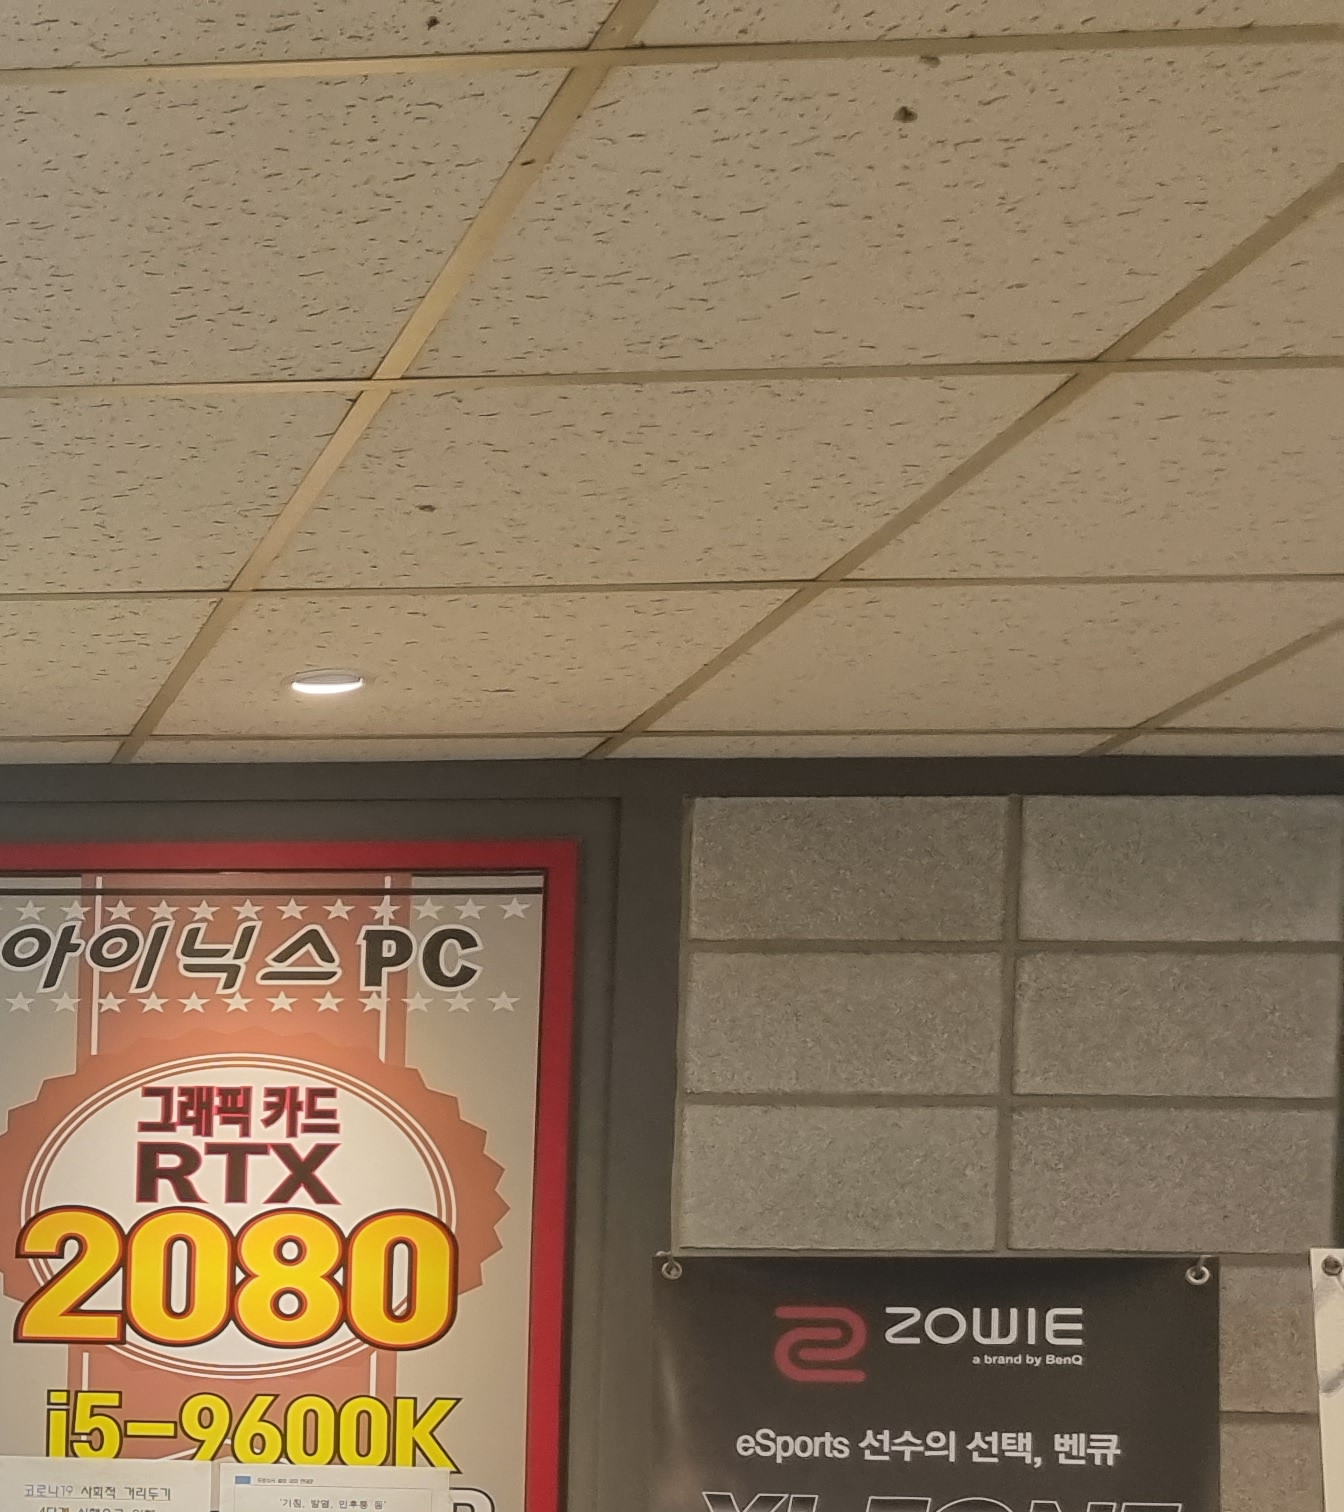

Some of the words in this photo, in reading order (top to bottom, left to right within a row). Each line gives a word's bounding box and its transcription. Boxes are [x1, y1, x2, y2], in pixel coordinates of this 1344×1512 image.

[357, 922, 484, 993] PC
[137, 1085, 254, 1138] 그래픽
[260, 1086, 342, 1139] 카드
[135, 1141, 342, 1206] RTX
[12, 1205, 459, 1352] 2080
[884, 1306, 1084, 1346] ZOWIE
[971, 1356, 981, 1365] a
[983, 1353, 1023, 1366] brand
[1025, 1354, 1043, 1369] by
[1045, 1354, 1084, 1367] BenQ
[45, 1388, 464, 1475] i5-9600K
[735, 1428, 850, 1464] eSports
[858, 1430, 956, 1464] 선수의
[966, 1431, 1043, 1467] 선택,
[1052, 1431, 1121, 1467] 벤큐
[23, 1483, 74, 1499] 코로나19
[80, 1485, 117, 1500] 사회적
[123, 1486, 172, 1501] 거리두기
